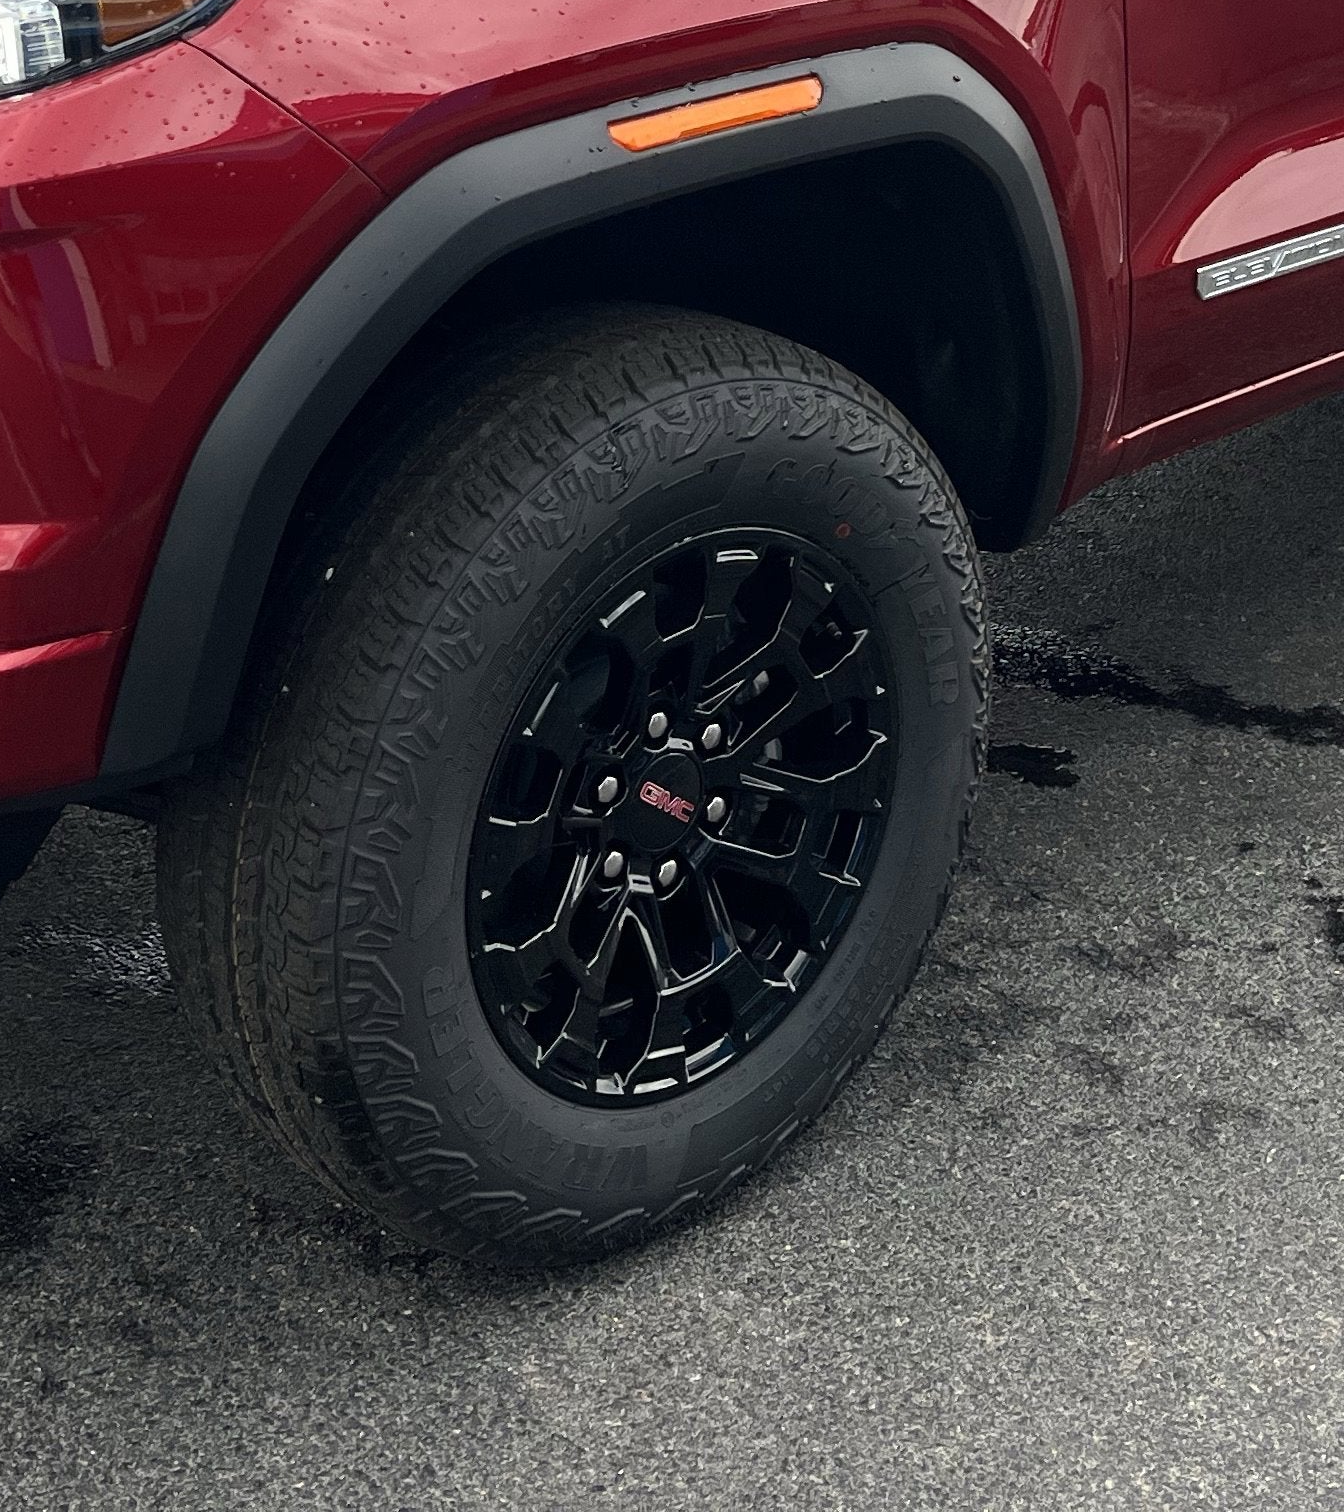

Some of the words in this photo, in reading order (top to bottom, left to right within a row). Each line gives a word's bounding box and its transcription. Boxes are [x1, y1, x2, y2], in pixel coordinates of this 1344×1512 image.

[765, 453, 960, 711] GOODYEAR
[639, 780, 695, 823] GMC
[420, 964, 649, 1192] WRANGLER
